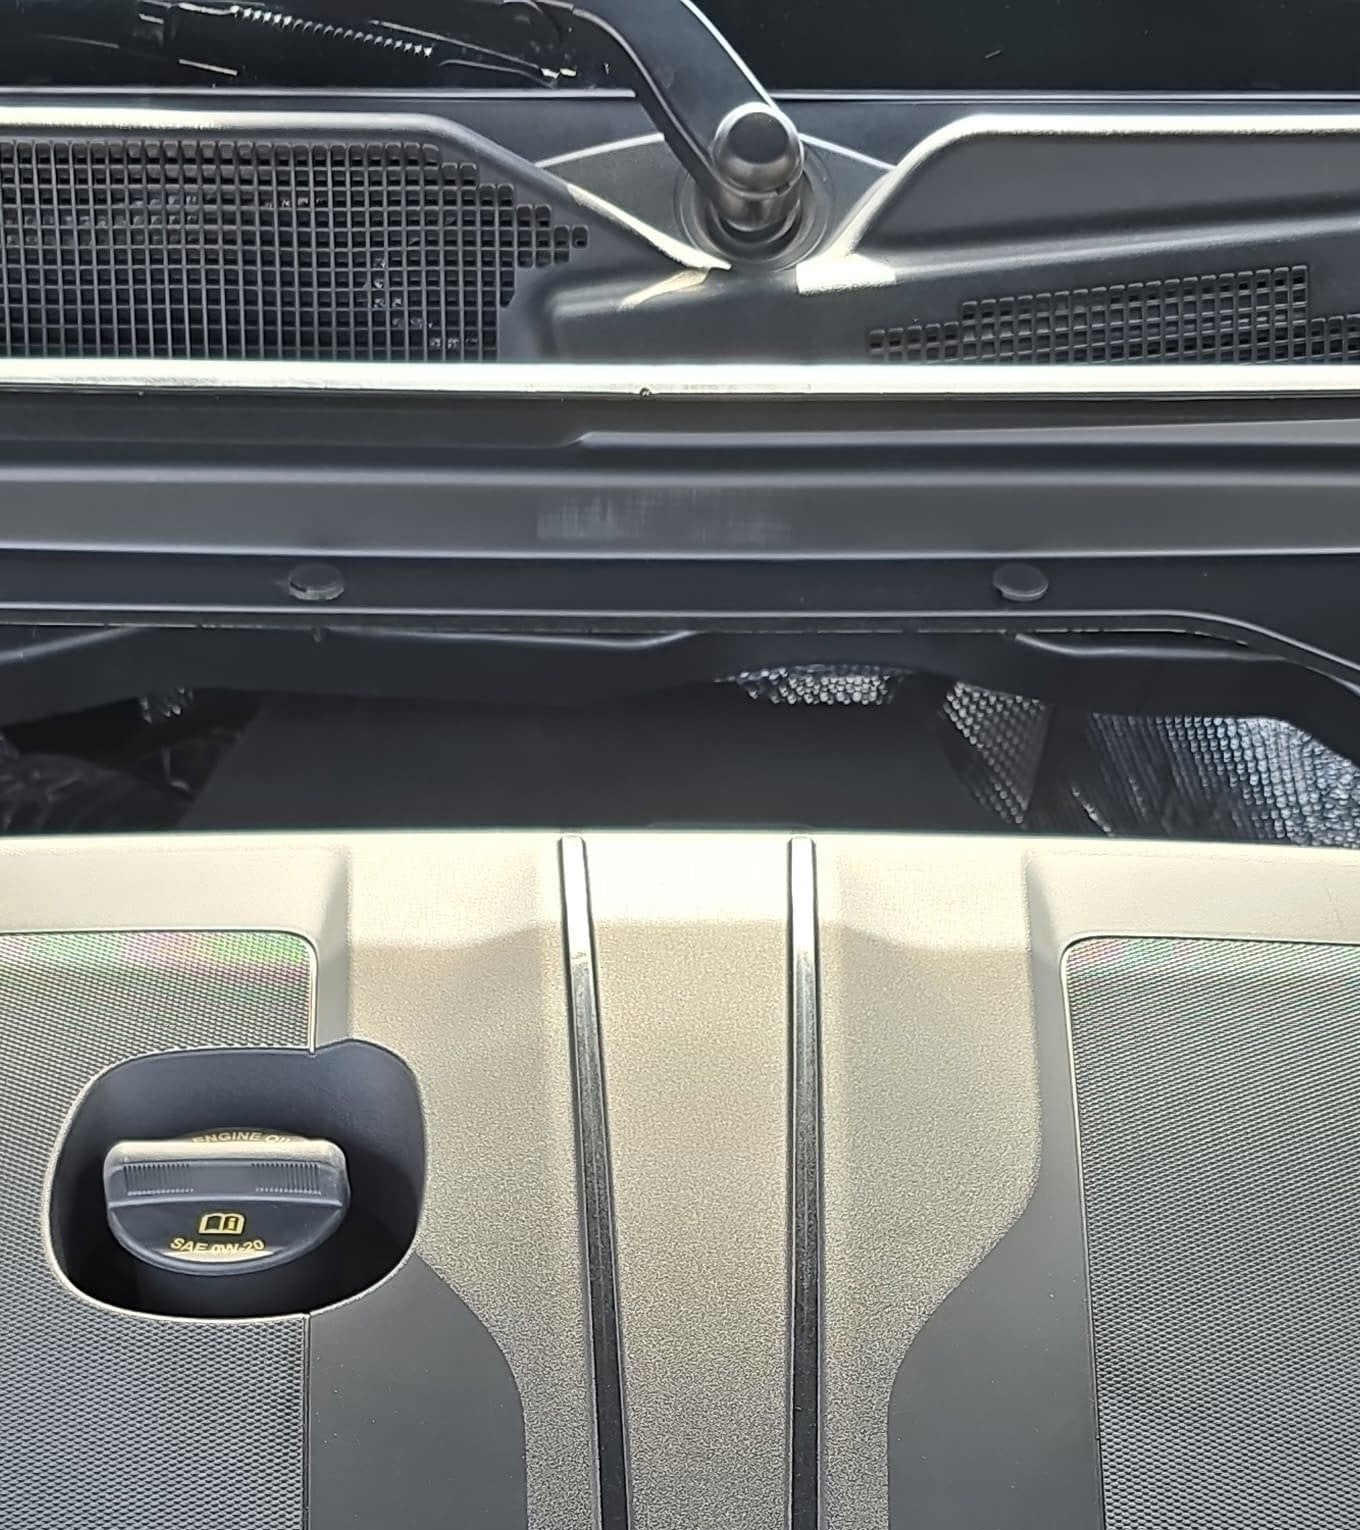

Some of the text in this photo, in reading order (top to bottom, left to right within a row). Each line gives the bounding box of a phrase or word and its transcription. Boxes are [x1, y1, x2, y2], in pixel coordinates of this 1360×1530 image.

[192, 1132, 262, 1143] ENGINE
[170, 1237, 265, 1254] SAE 0W-20
